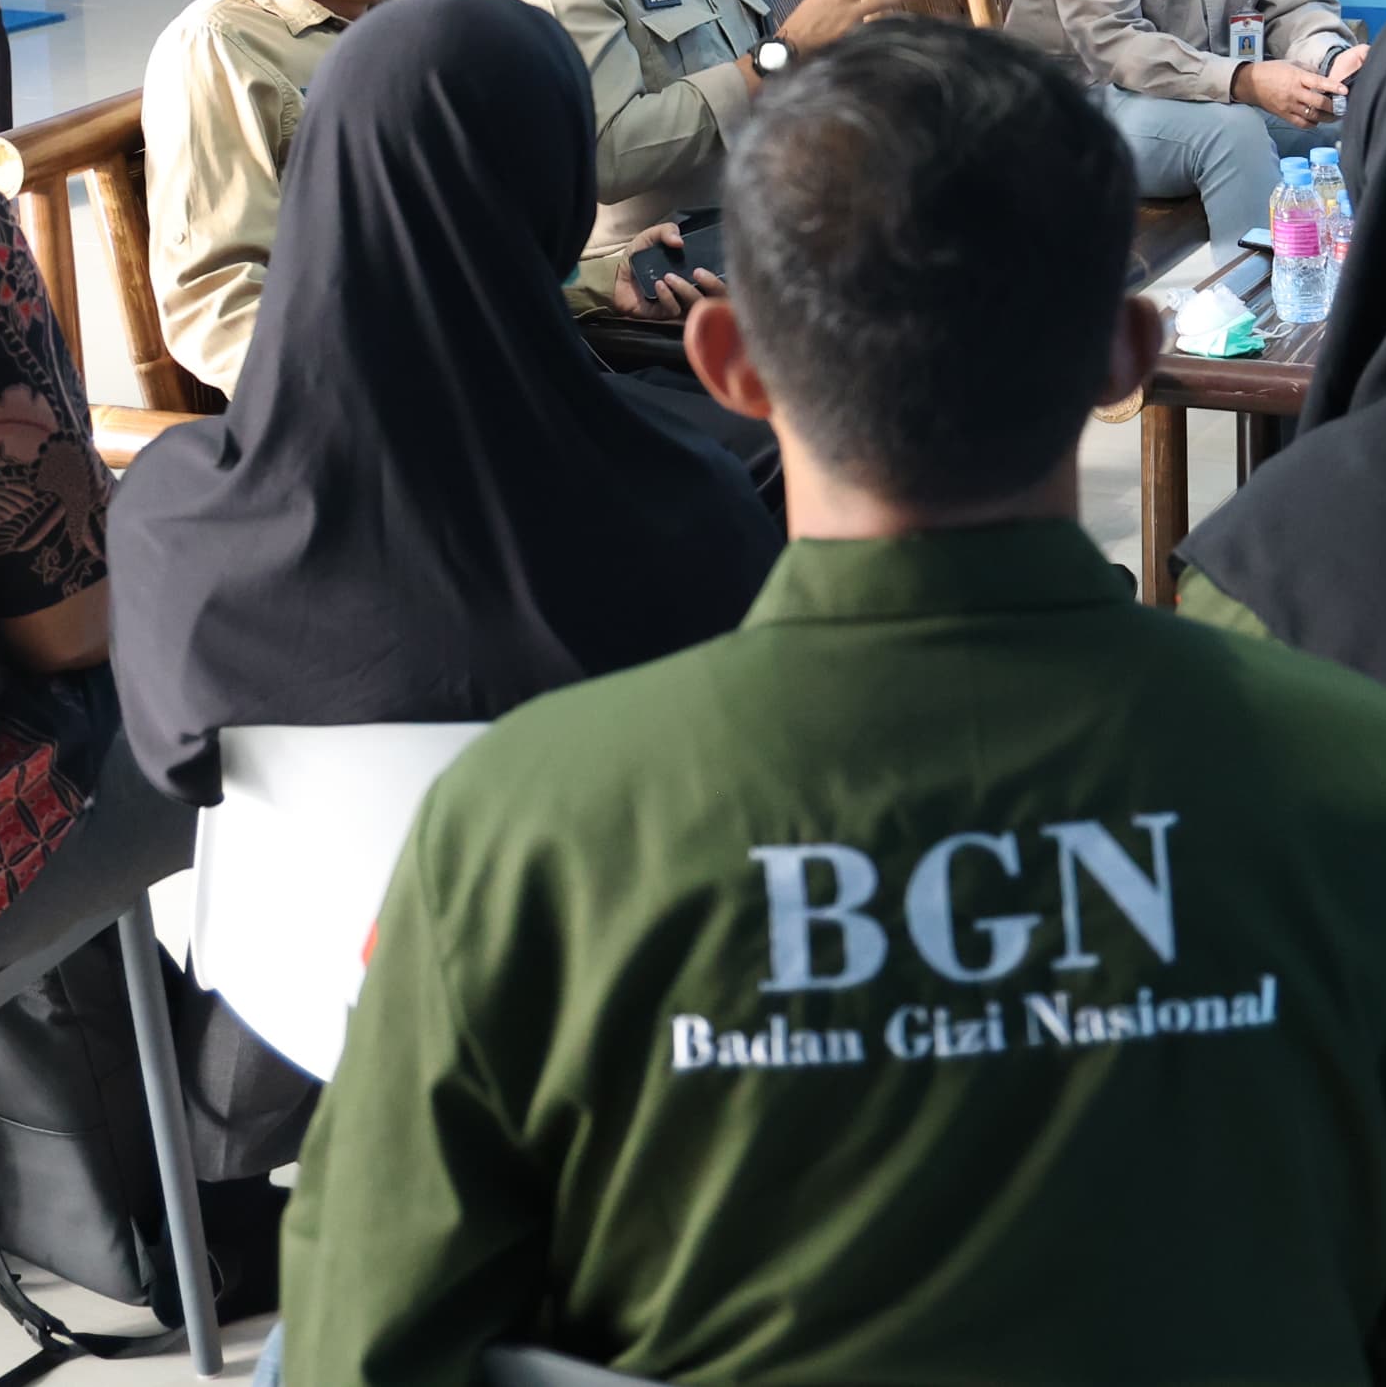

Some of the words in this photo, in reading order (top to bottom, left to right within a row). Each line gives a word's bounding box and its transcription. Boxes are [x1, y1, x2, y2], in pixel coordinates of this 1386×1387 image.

[748, 812, 1179, 993] BGN
[670, 1014, 866, 1071] Badan
[884, 1002, 1007, 1060] Gizi
[1024, 974, 1278, 1048] Nasional
